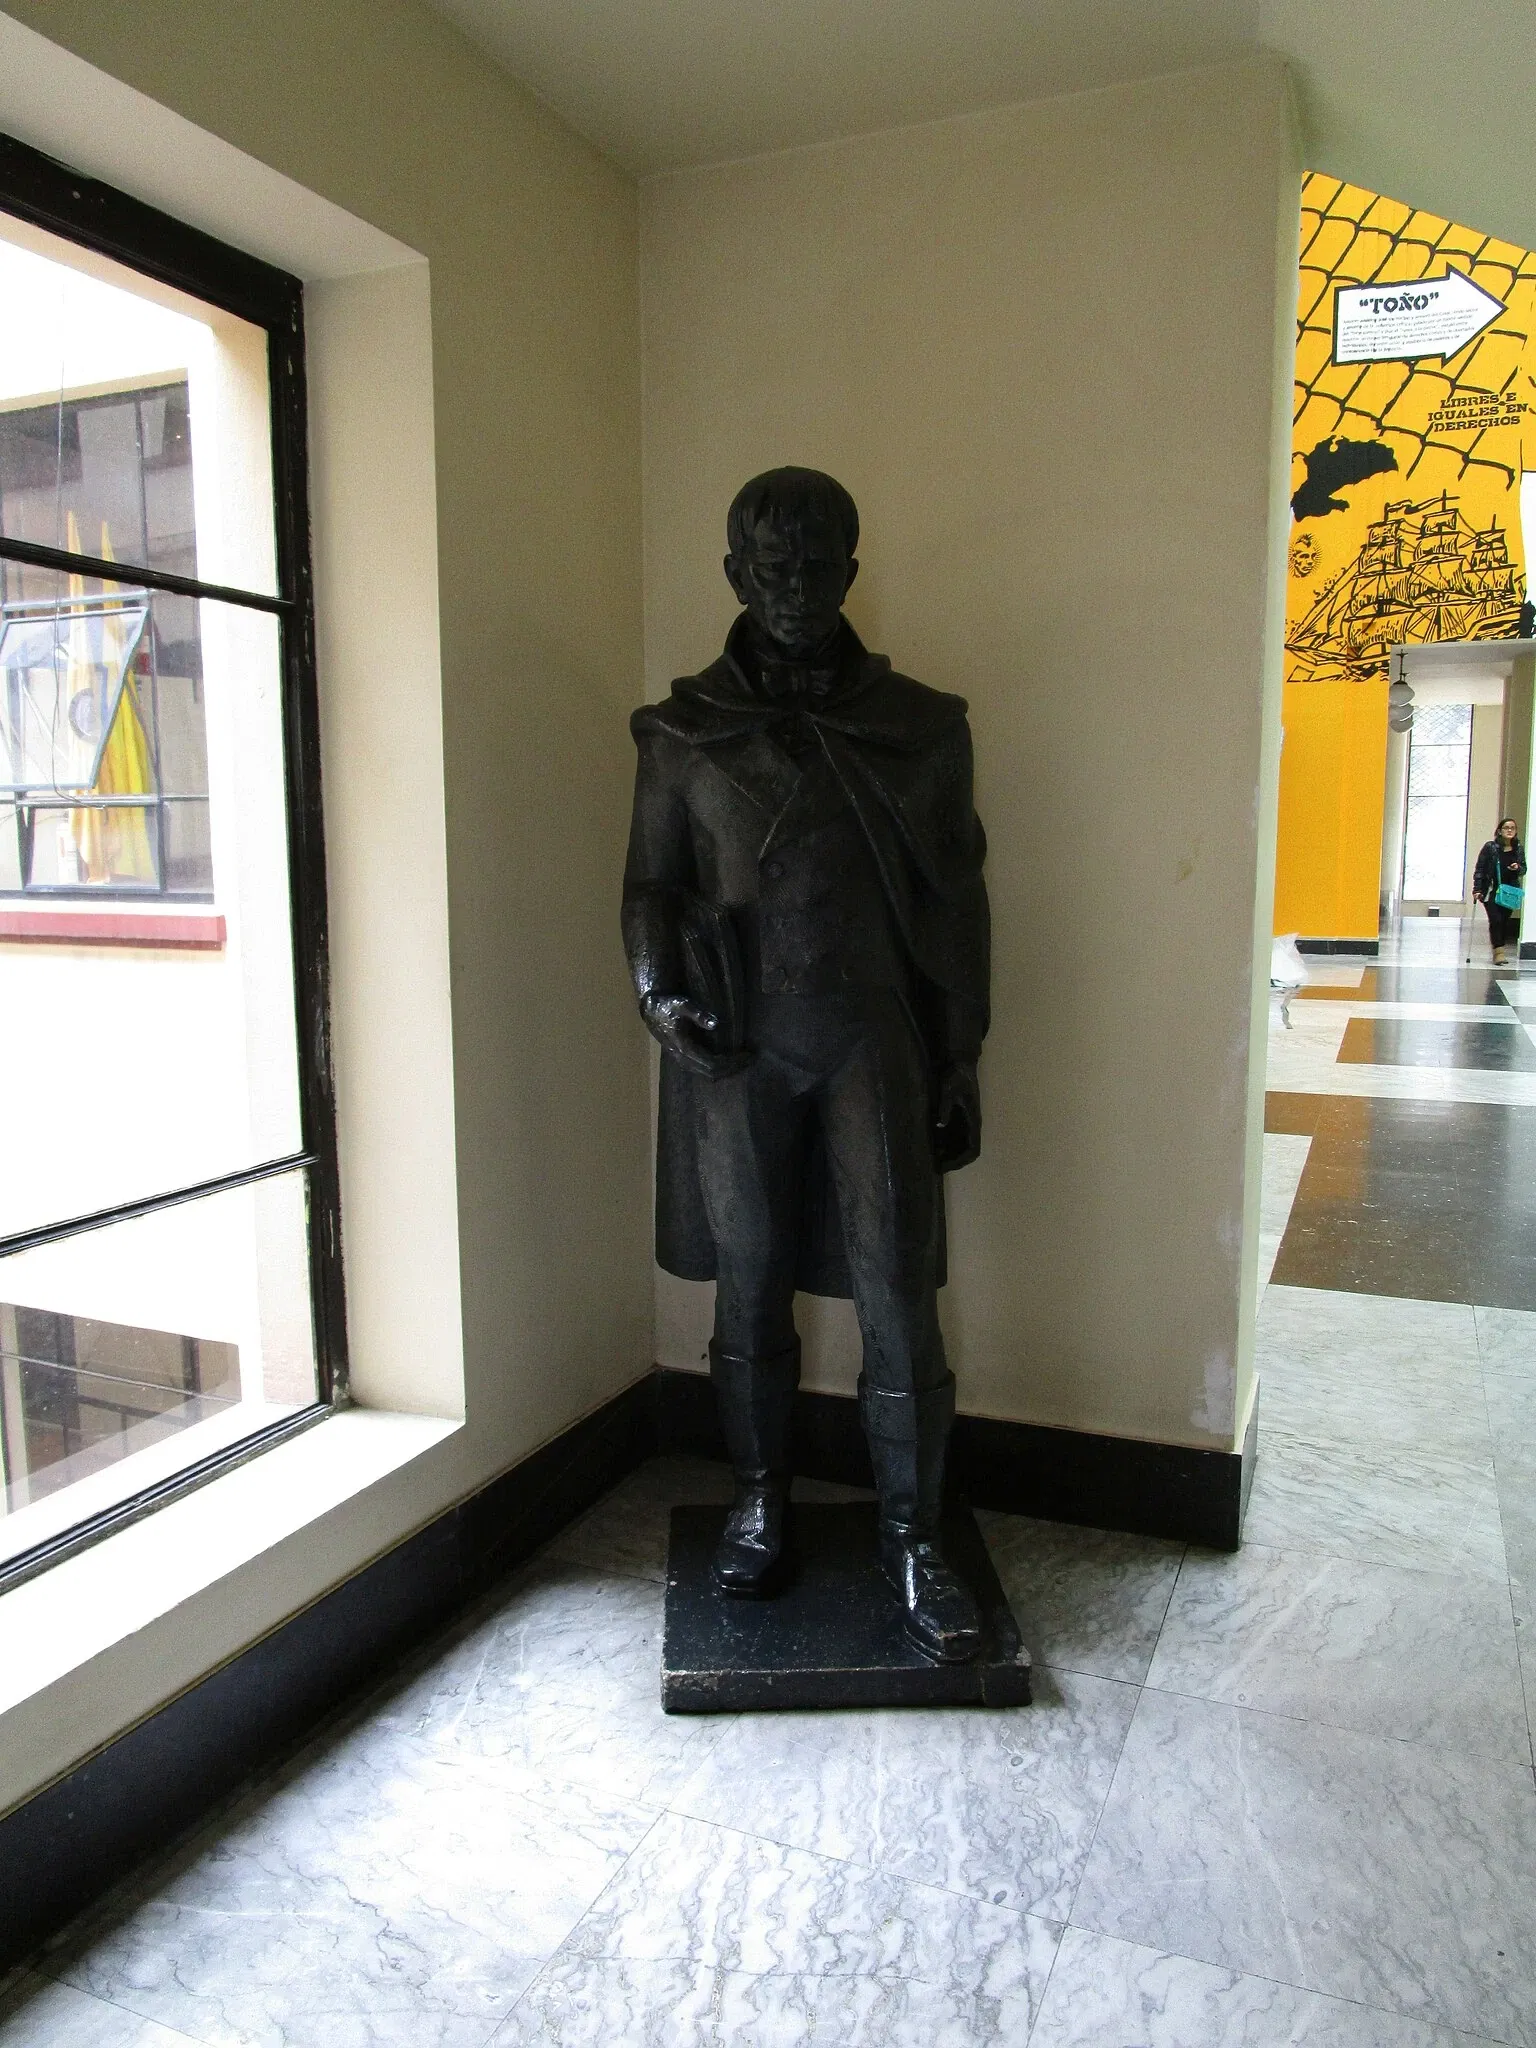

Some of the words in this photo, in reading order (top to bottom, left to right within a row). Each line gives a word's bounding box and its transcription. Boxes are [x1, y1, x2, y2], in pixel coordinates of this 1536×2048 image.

[1359, 291, 1439, 314] “TOÑO”
[1440, 394, 1499, 408] LIBRES
[1506, 392, 1516, 402] E
[1428, 406, 1499, 421] IGUALES
[1506, 403, 1528, 413] EN
[1434, 416, 1520, 432] DERECHOS
